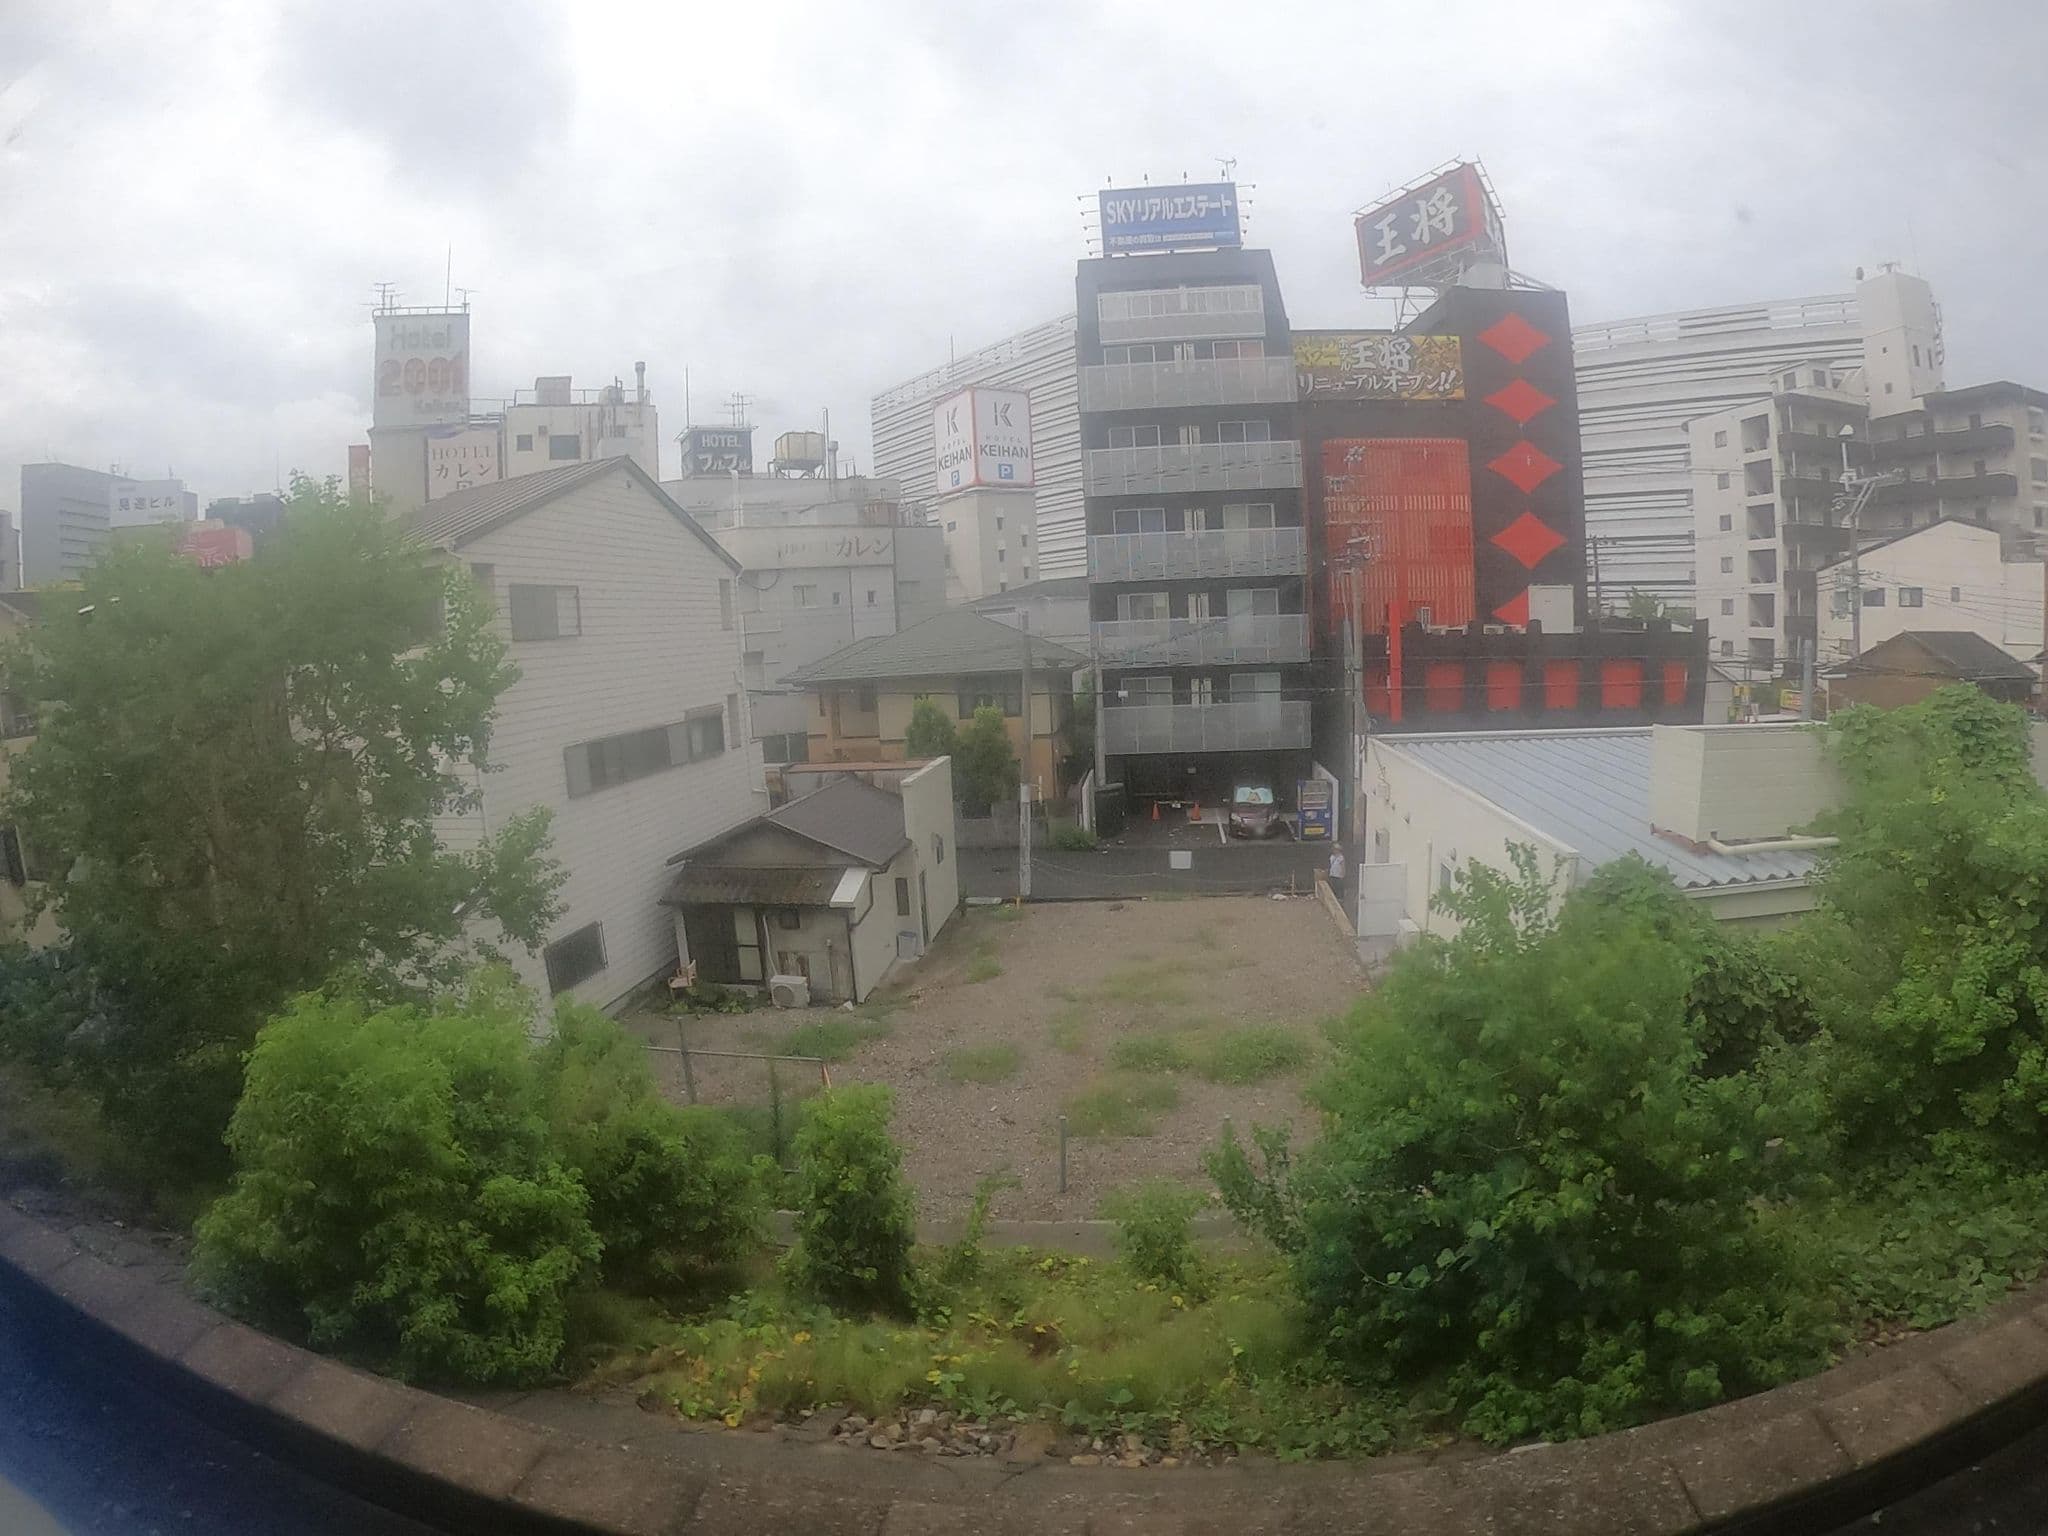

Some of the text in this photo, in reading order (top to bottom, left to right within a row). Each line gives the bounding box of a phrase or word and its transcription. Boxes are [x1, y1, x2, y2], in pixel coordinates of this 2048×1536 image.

[1106, 193, 1232, 224] SKYリアルエステート
[1373, 187, 1459, 265] 王将
[379, 352, 464, 396] 2001
[702, 434, 742, 448] HOTEL
[979, 444, 1029, 458] KEIHAN
[937, 444, 972, 472] KEIHAN
[435, 463, 491, 479] カレン
[836, 535, 891, 558] カレン
